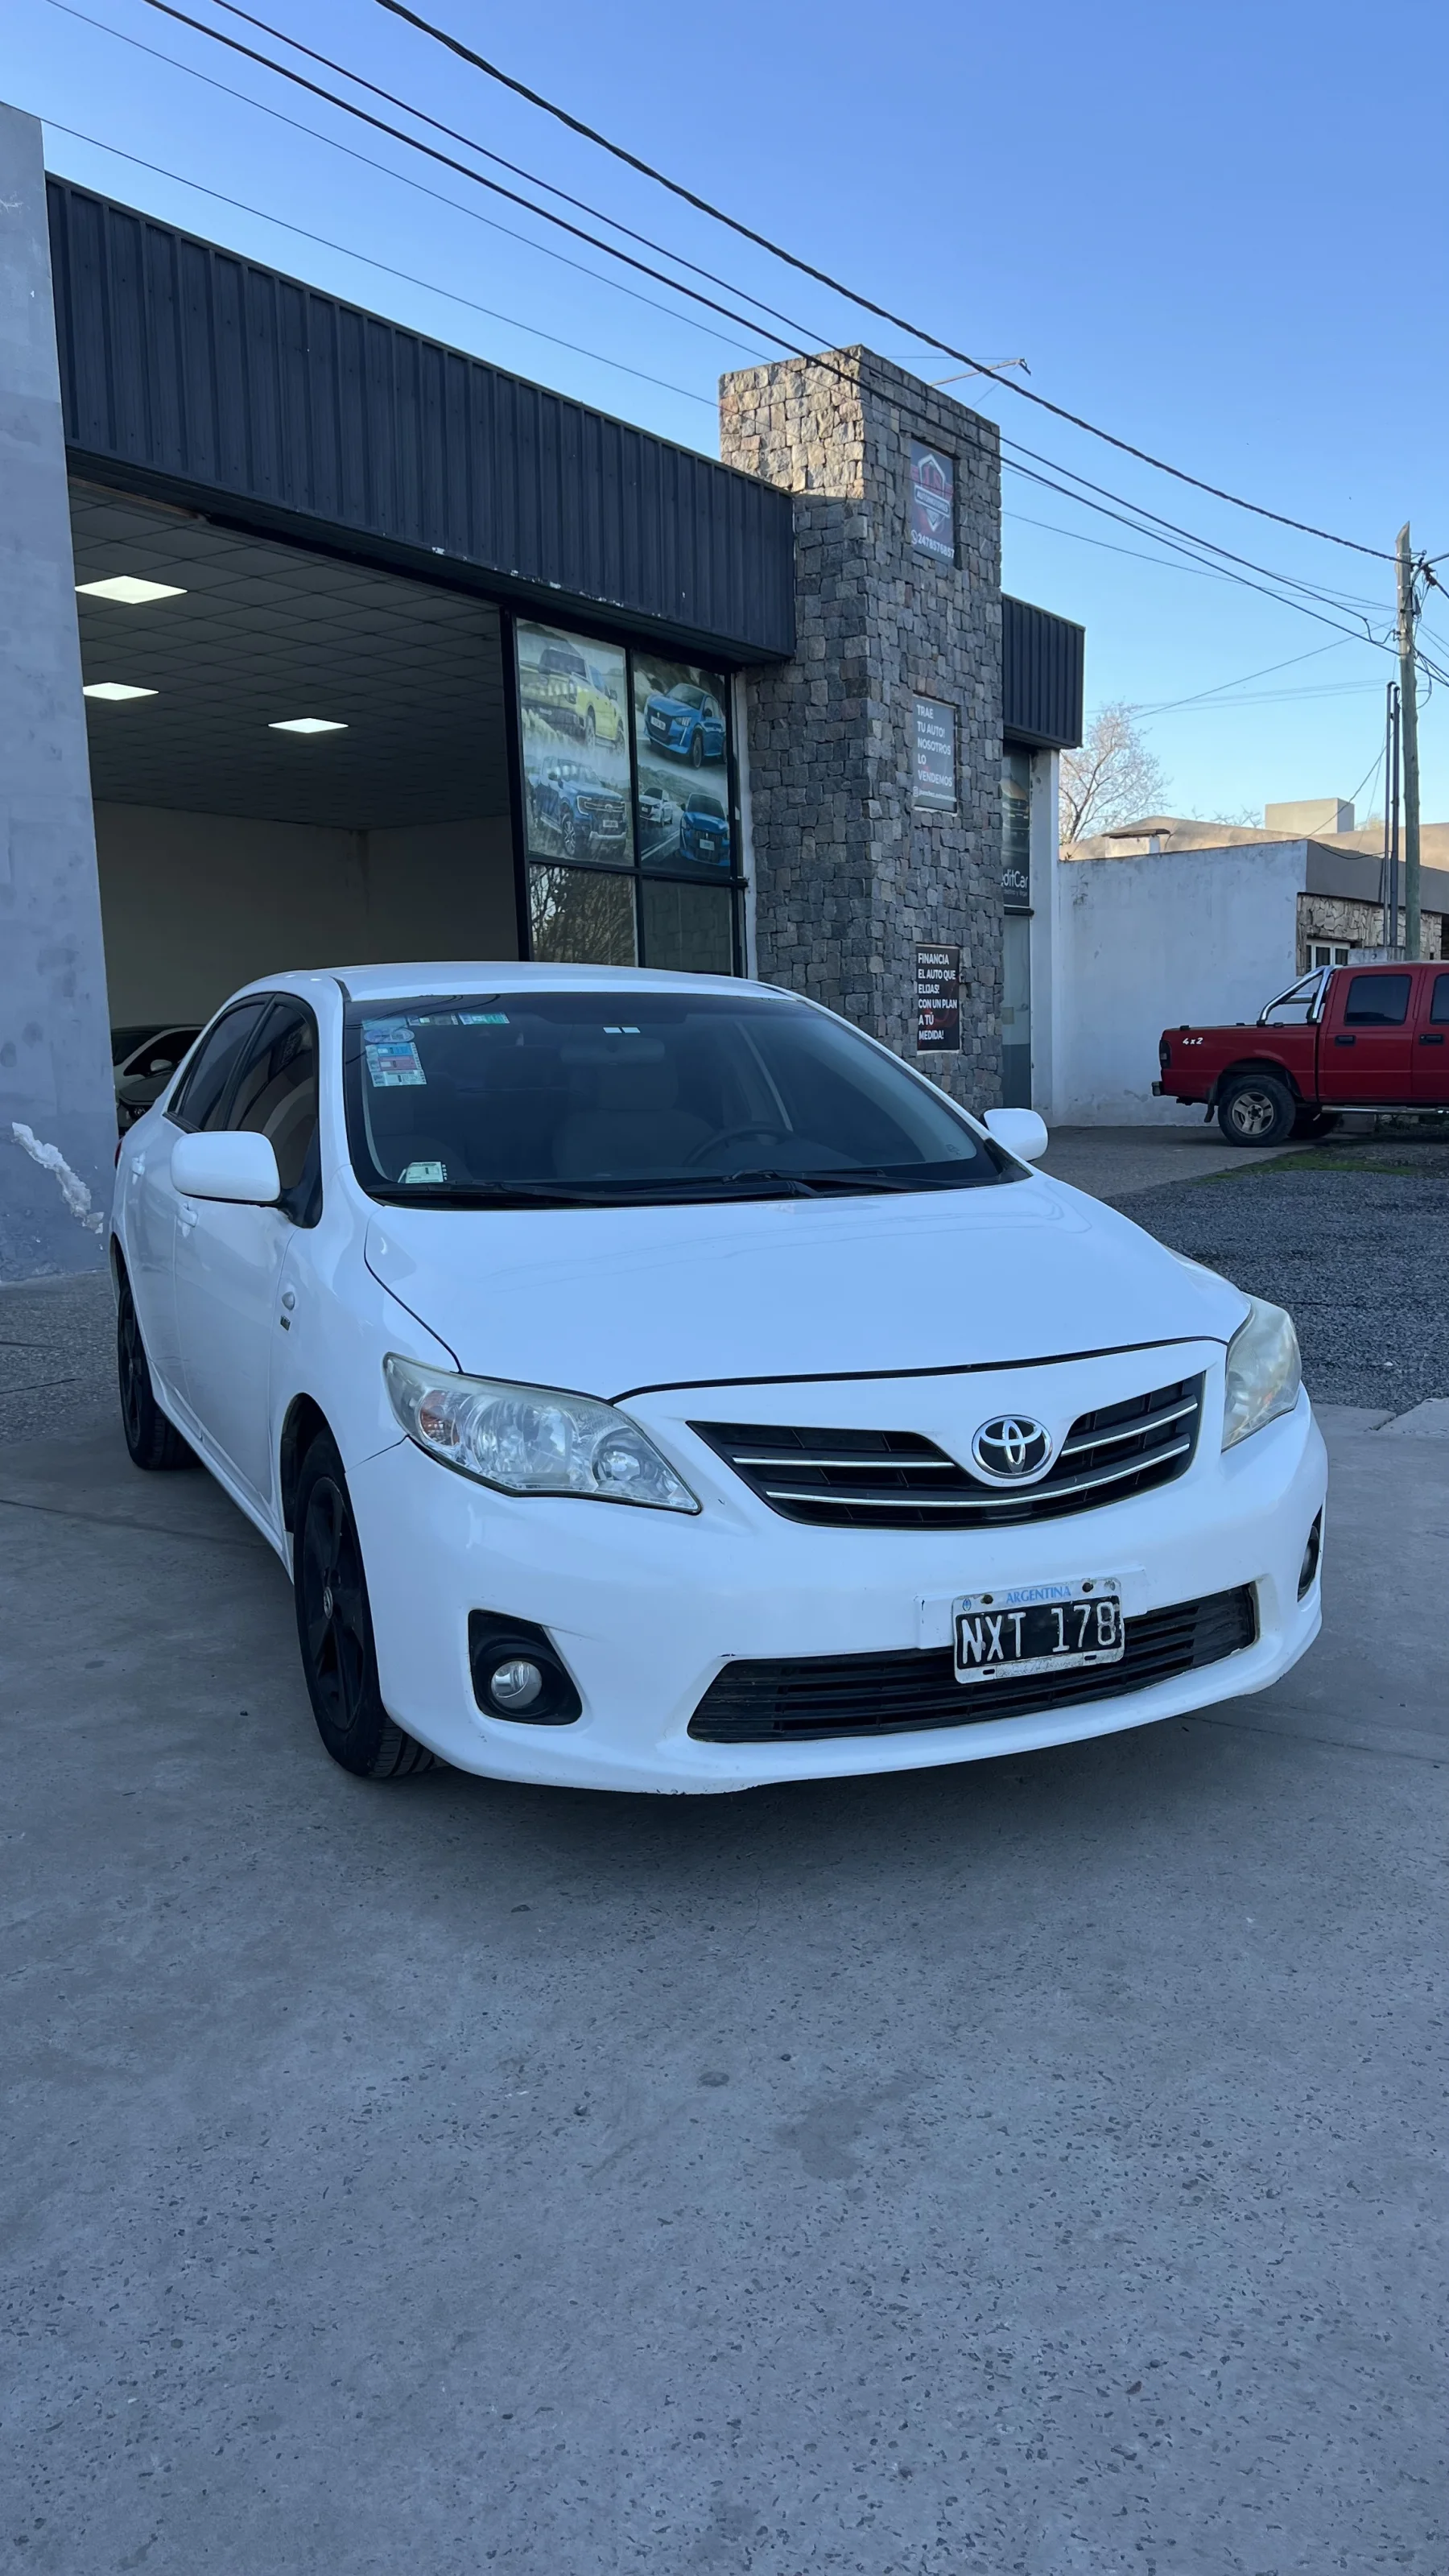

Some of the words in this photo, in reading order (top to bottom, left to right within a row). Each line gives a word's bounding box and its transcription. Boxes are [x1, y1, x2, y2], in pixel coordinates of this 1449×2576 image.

[916, 704, 934, 719] TRAE
[917, 721, 926, 733] TU
[926, 723, 945, 738] AUTO!
[917, 737, 952, 756] NOSOTROS
[918, 754, 927, 766] LO
[918, 770, 953, 787] VENDEMOS
[918, 952, 949, 965] FINANCIA
[918, 968, 926, 979] EL
[927, 969, 943, 980] AUTO
[943, 970, 956, 981] QUE
[918, 999, 932, 1009] CON
[932, 999, 942, 1009] UN
[942, 999, 957, 1009] PLAN
[918, 1014, 924, 1026] A
[919, 1030, 944, 1040] MEDIDA!
[1183, 1037, 1203, 1045] 4x2
[1006, 1586, 1071, 1604] ARGENTINA
[961, 1612, 1026, 1665] NXT
[1051, 1601, 1117, 1653] 178
